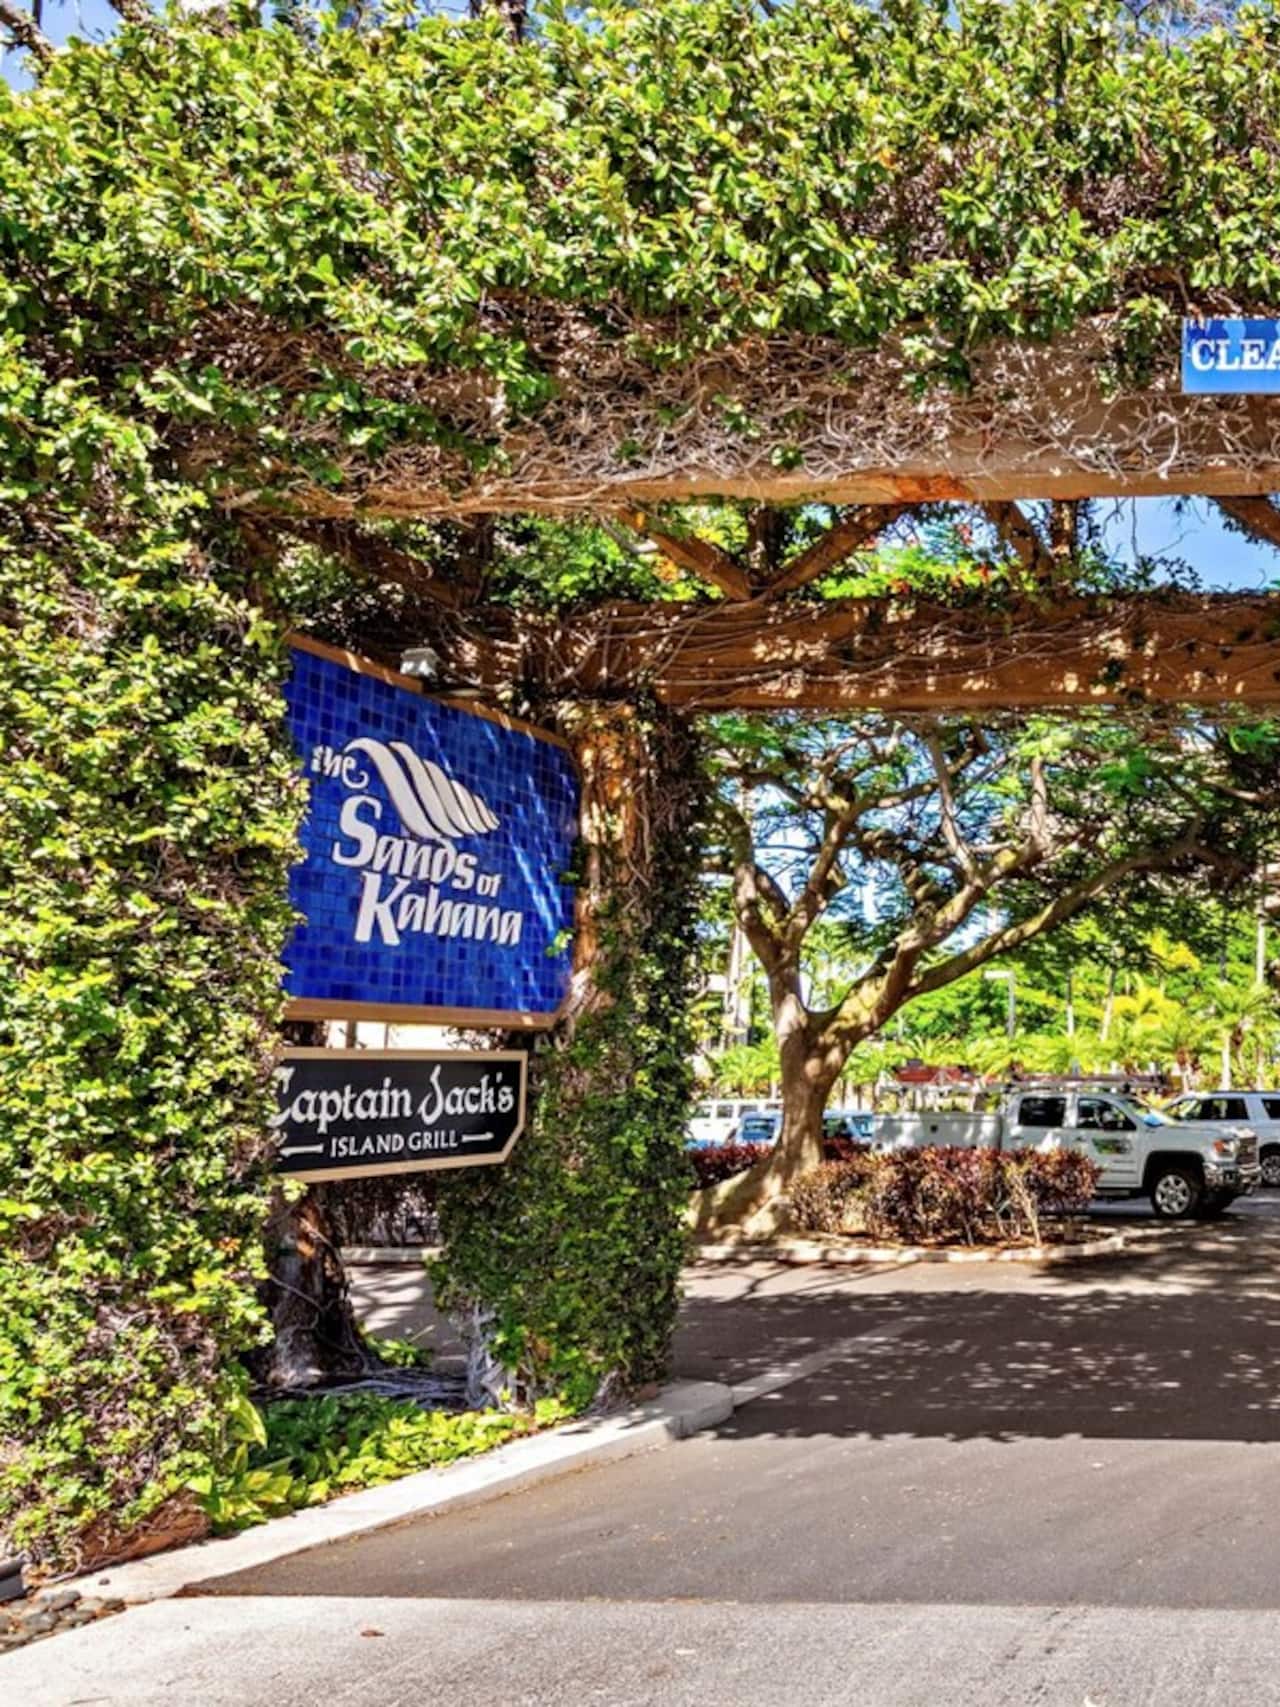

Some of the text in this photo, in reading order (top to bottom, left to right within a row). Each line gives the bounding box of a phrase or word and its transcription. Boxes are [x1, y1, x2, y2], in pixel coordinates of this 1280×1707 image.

[310, 744, 369, 789] the
[332, 795, 501, 898] Sands of
[354, 870, 523, 946] Kahana
[417, 1063, 514, 1126] Jack's
[330, 1129, 458, 1158] ISLAND GRILL
